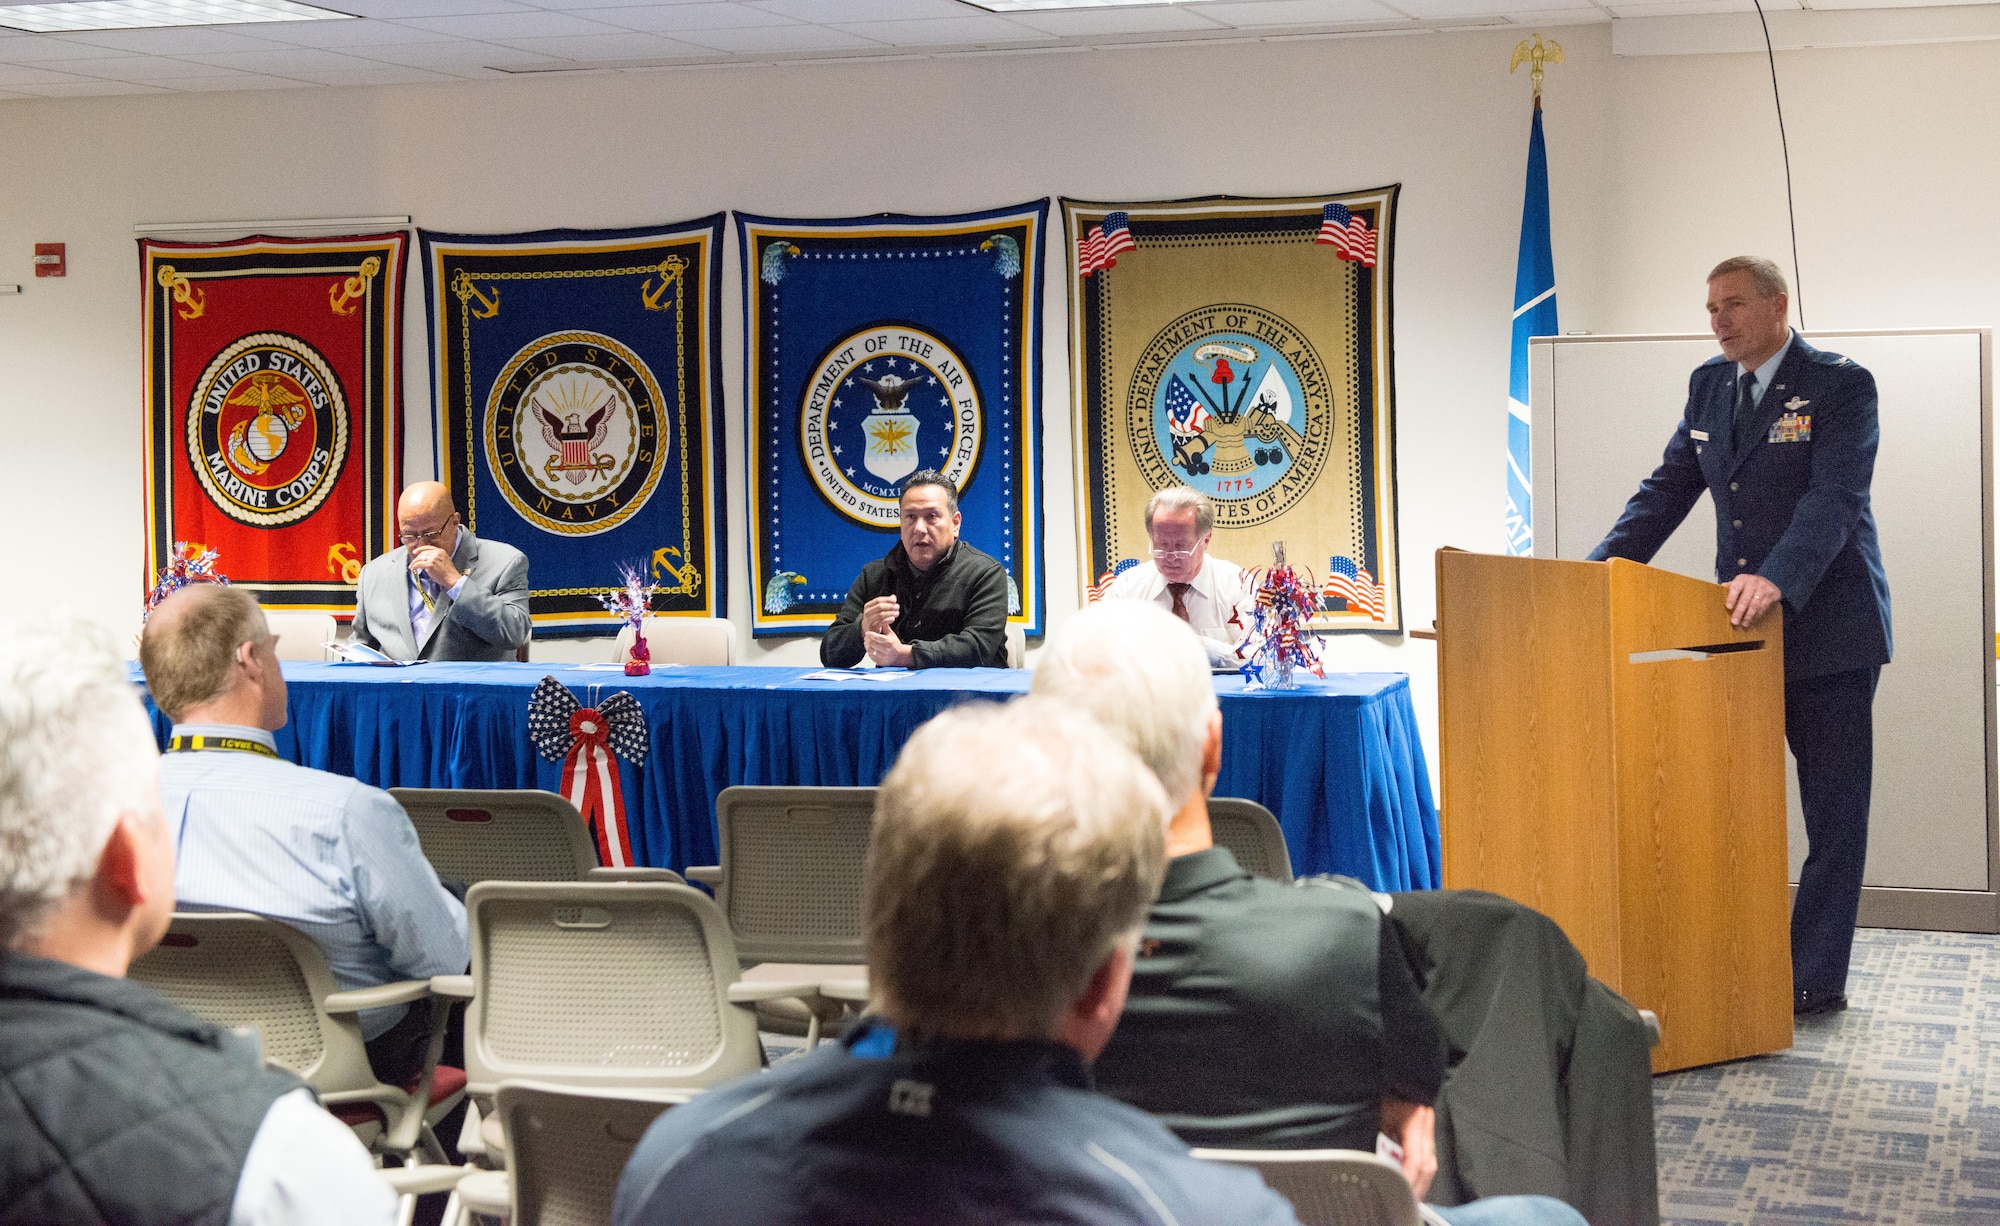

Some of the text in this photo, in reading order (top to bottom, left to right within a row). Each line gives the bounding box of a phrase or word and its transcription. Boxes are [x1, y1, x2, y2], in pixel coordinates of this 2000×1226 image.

[204, 352, 328, 415] UNITED STATES
[1135, 315, 1323, 410] DEPARTMENT OF THE ARMY
[499, 348, 654, 466] UNITED STATES
[808, 335, 975, 461] DEPARTMENT OF THE AIR FORCE
[207, 447, 330, 508] MARINE CORPS
[820, 466, 900, 518] UNITED STATES
[1215, 503, 1250, 518] TES
[1256, 492, 1278, 511] OF
[1282, 413, 1325, 497] AMERICA
[1217, 477, 1254, 492] 1775
[537, 492, 619, 519] NAVY
